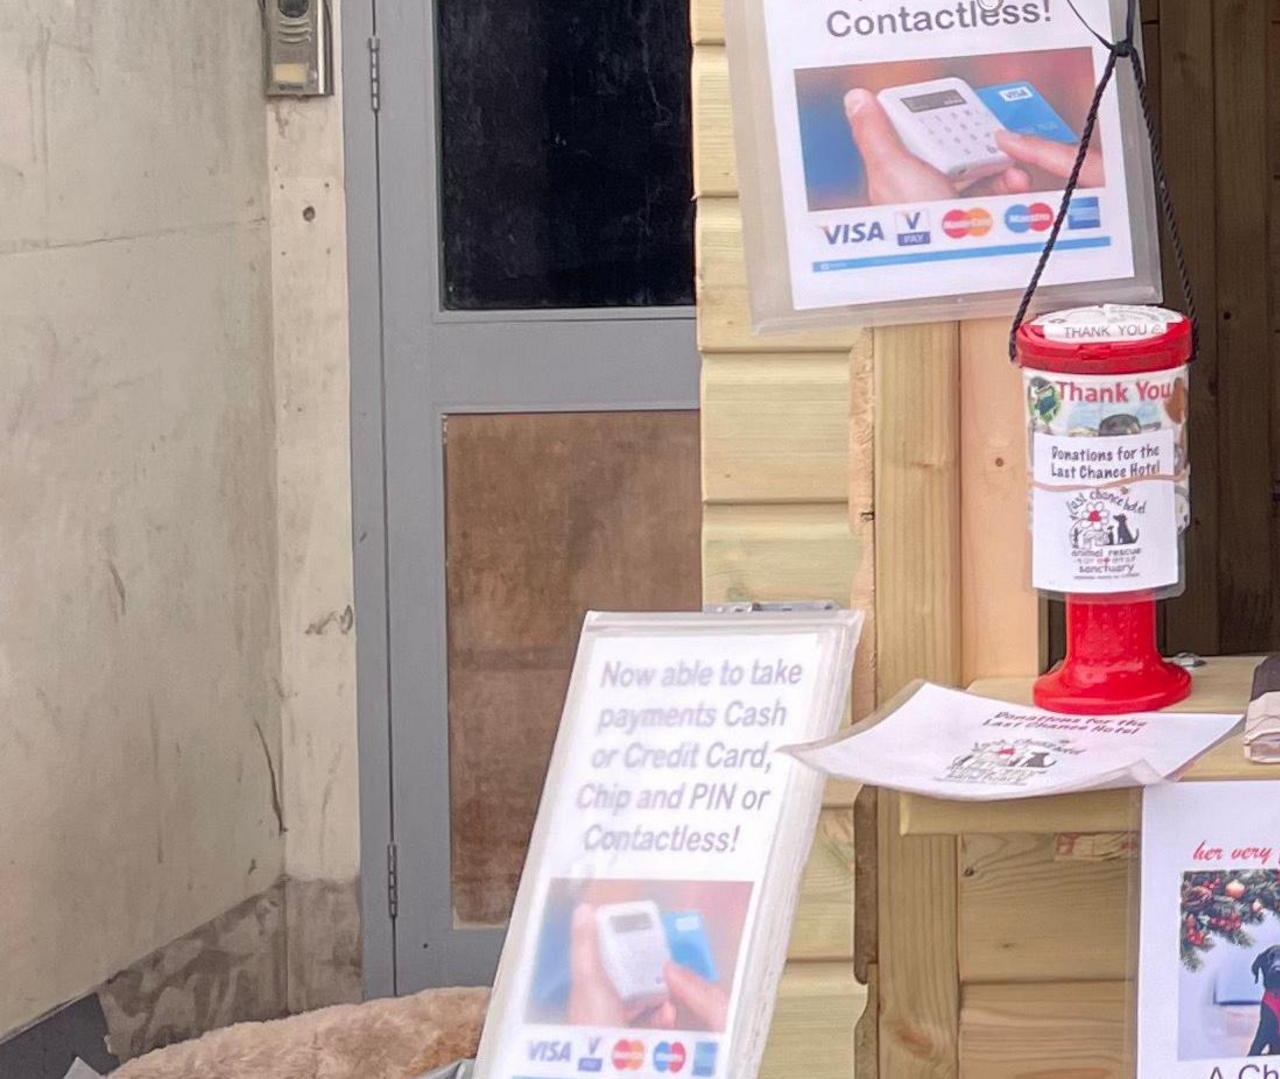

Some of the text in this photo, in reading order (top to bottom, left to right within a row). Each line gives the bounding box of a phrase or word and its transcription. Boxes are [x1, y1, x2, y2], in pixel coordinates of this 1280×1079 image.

[823, 222, 884, 244] VISA
[907, 212, 920, 230] V
[1064, 324, 1147, 338] THANK YOU
[1055, 381, 1172, 403] Thank You
[1051, 444, 1159, 461] Donations for the
[1051, 460, 1160, 479] Last Chance Hotel
[600, 659, 802, 689] Now able to take
[598, 700, 787, 734] payments Cash
[591, 742, 772, 773] or Credit Card,
[576, 782, 771, 811] Chip and PIN or
[584, 826, 739, 851] Contactless!
[1192, 840, 1224, 862] her
[1231, 845, 1272, 864] very
[528, 1041, 572, 1062] VISA
